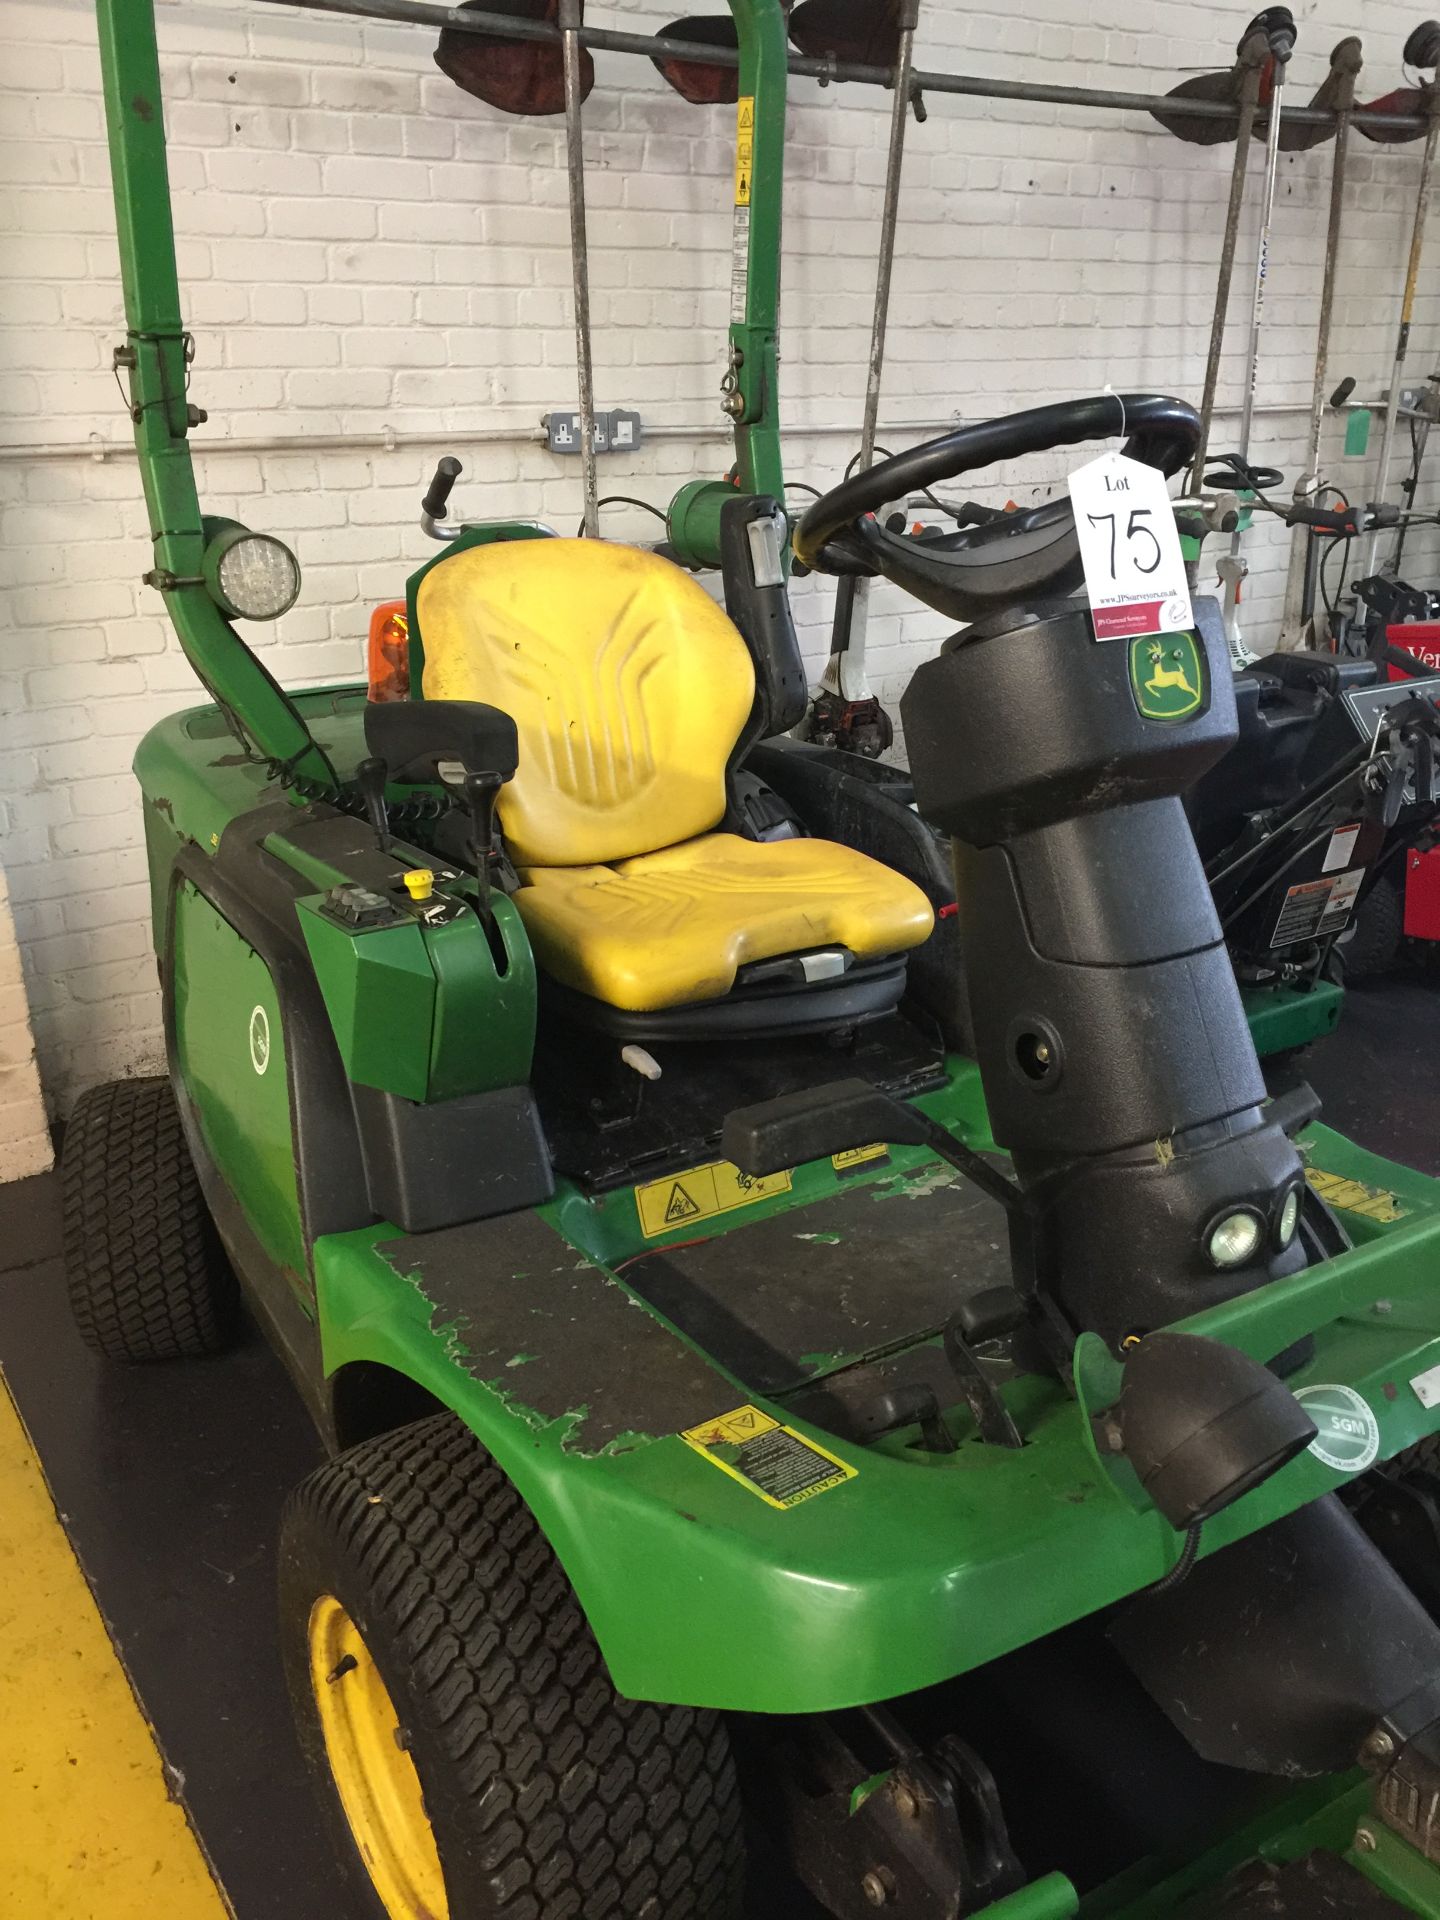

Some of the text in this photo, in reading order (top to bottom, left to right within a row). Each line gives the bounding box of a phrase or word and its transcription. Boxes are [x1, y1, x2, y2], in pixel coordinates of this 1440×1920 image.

[1104, 475, 1130, 491] Lot
[1087, 509, 1162, 580] 75
[1407, 646, 1440, 669] Ve
[1331, 1415, 1366, 1435] SGM
[781, 1477, 839, 1507] CAUTION
